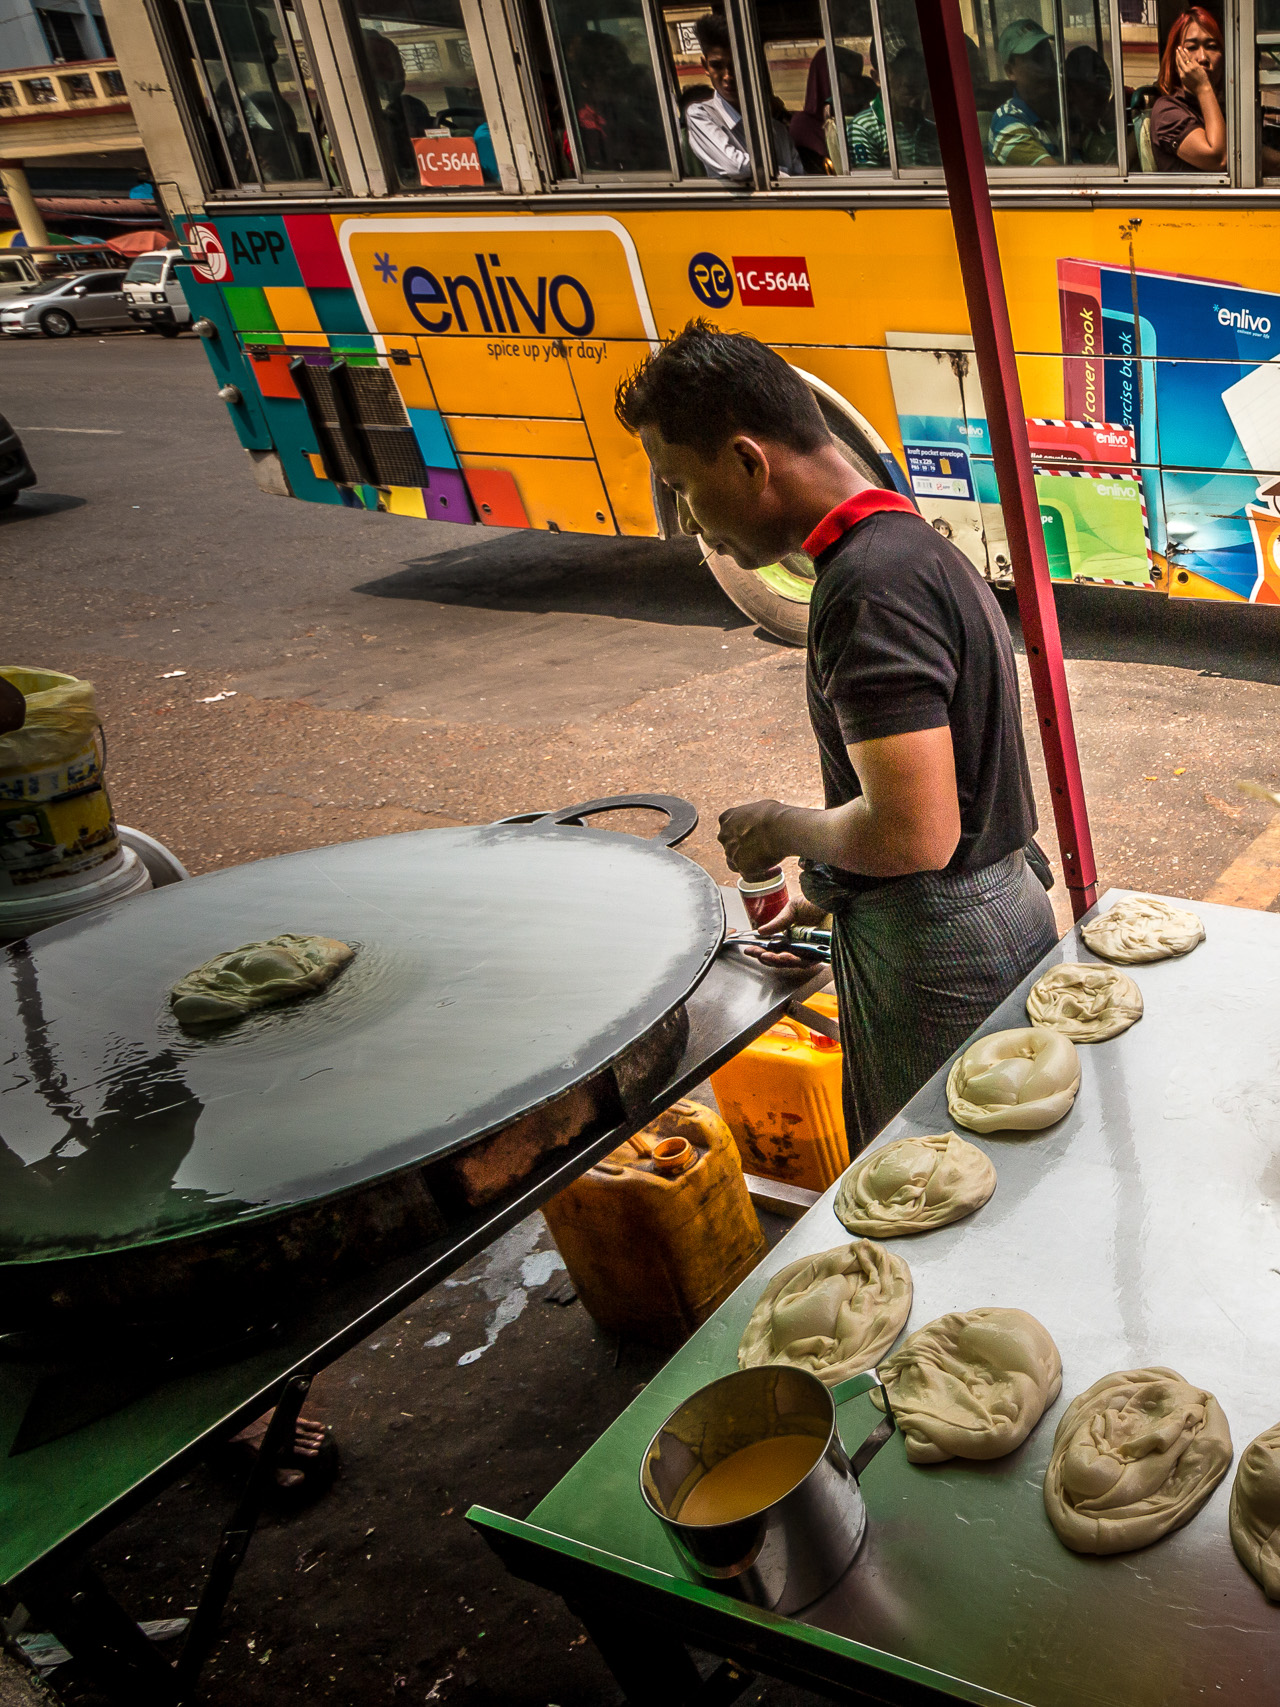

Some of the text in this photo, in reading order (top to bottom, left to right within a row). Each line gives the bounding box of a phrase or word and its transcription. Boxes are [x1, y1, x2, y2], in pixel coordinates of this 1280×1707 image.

[417, 152, 480, 171] 1C-5644
[231, 231, 285, 264] APP
[736, 271, 810, 291] 1C-5644
[1218, 308, 1271, 333] enlivo
[1080, 307, 1095, 359] book
[487, 340, 607, 364] spice up yor day!
[1119, 332, 1132, 378] book
[1085, 361, 1096, 413] cover
[1096, 432, 1128, 445] enlivo
[1096, 483, 1137, 498] enlivo
